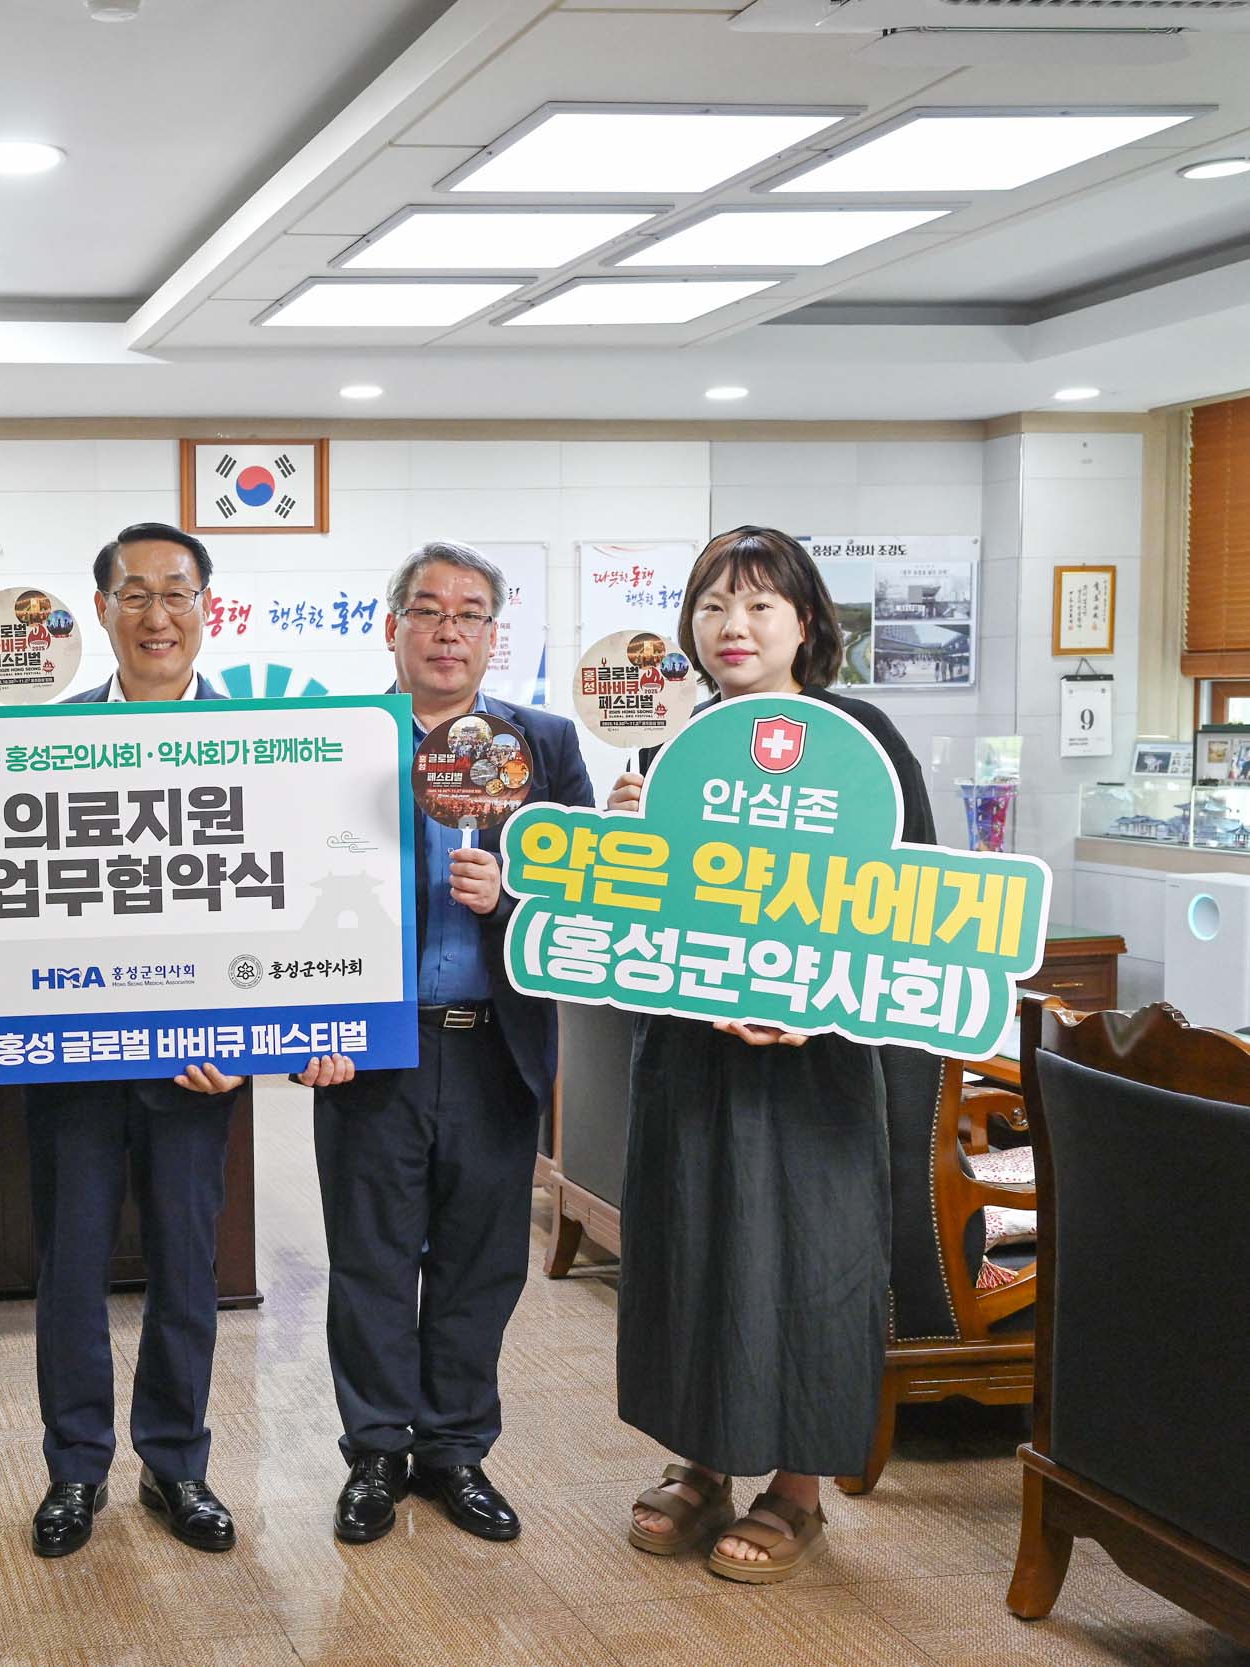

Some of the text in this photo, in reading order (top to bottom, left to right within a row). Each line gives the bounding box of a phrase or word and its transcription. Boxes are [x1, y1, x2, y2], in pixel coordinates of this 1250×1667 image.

[592, 565, 654, 588] 따뜻한 동행
[625, 585, 683, 609] 행복한 홍성
[206, 591, 378, 638] 동행 행복한 홍성
[583, 670, 595, 693] 홍성
[597, 666, 639, 680] 글로벌
[598, 680, 639, 694] 바비큐
[598, 695, 653, 709] 페스티벌
[1080, 708, 1095, 731] 9
[4, 741, 143, 774] 홍성군의사회
[157, 738, 250, 770] 약사회가
[253, 736, 343, 766] 함께하는
[702, 777, 839, 835] 안심존
[2, 786, 245, 851] 의료지원
[520, 821, 1027, 957] 약은 약사에게
[31, 966, 106, 990] HMA
[111, 964, 195, 981] 홍성군의사회
[268, 958, 362, 980] 홍성군약사회
[522, 910, 990, 1038] (홍성군약사회)
[60, 1028, 151, 1062] 글로벌
[156, 1024, 246, 1059] 바비큐
[251, 1020, 368, 1056] 페스티벌
